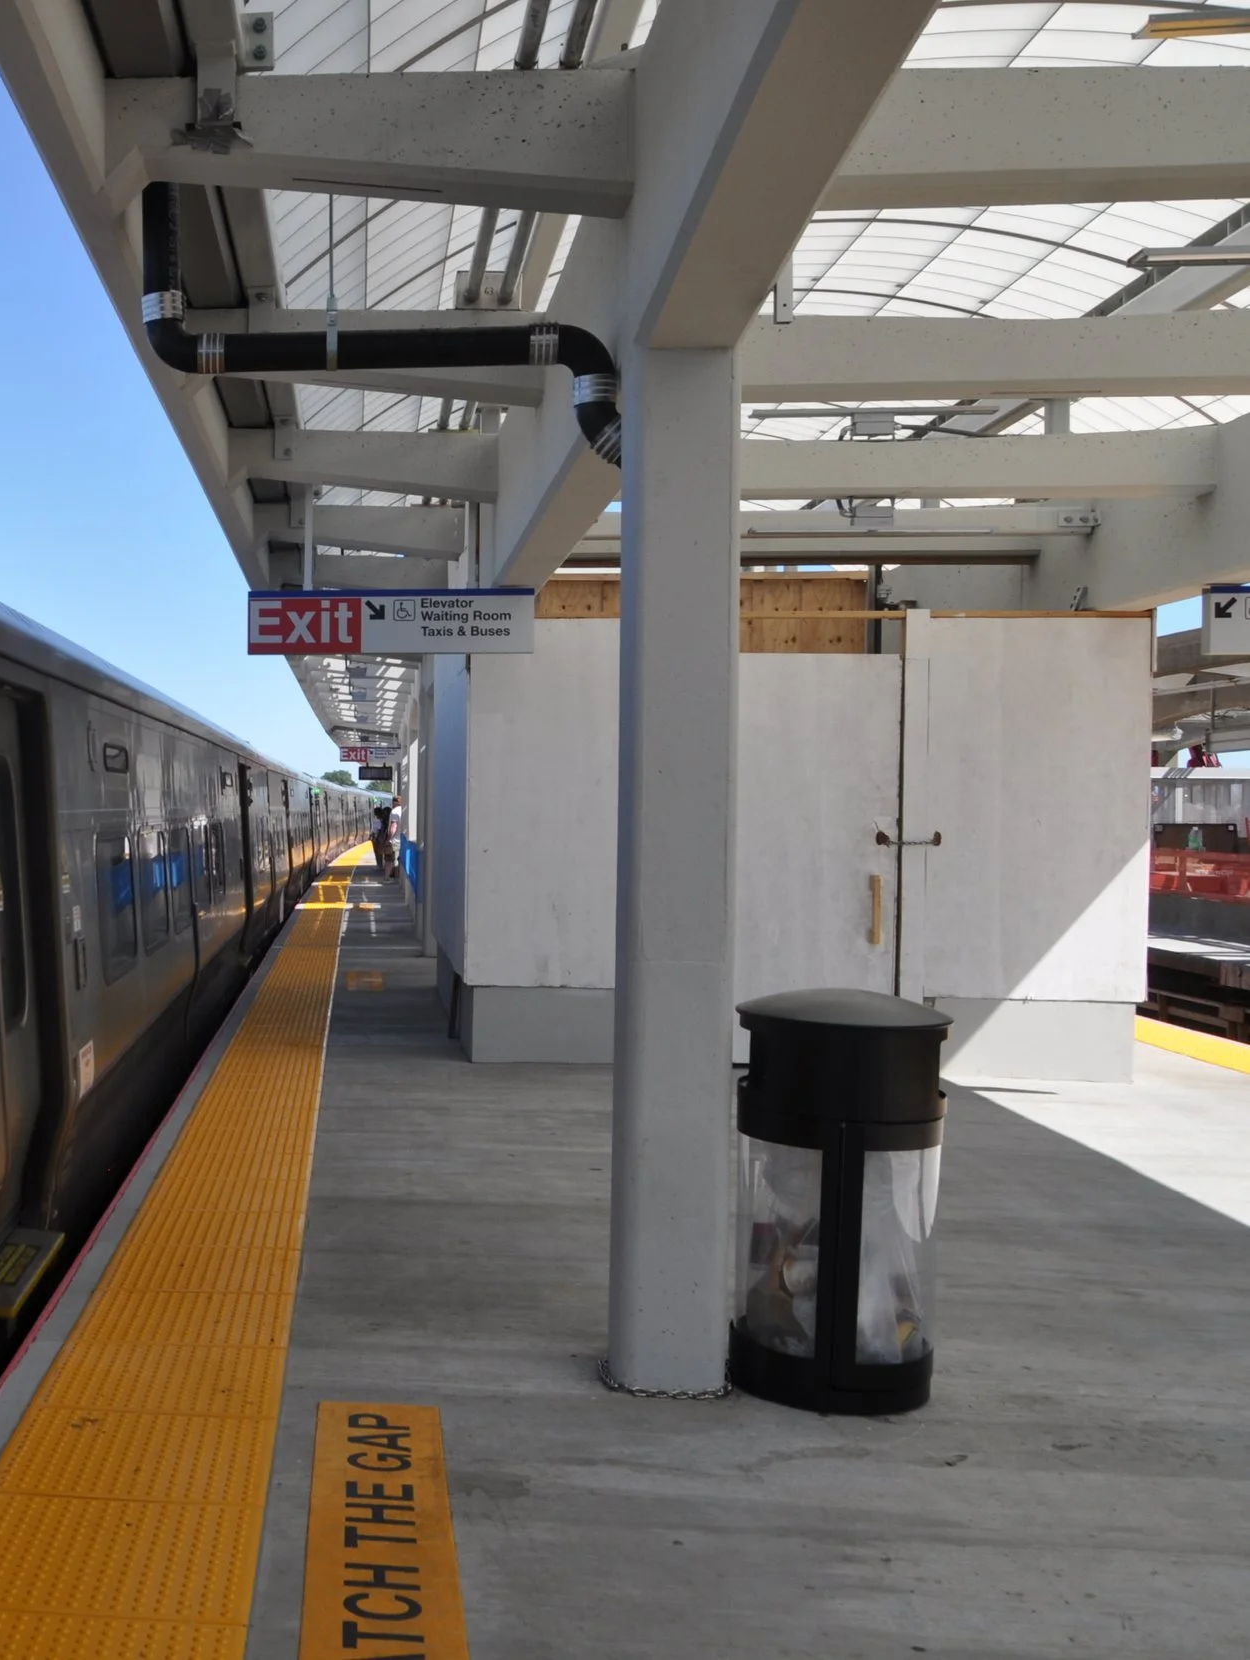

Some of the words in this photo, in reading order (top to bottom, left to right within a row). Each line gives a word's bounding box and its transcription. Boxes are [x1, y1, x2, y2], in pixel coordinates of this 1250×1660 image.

[420, 598, 474, 609] Elevator
[420, 611, 469, 623] Waiting
[473, 611, 512, 622] Room
[250, 600, 353, 644] Exit
[420, 626, 454, 637] Taxis
[456, 626, 466, 637] &
[470, 626, 511, 637] Buses
[341, 749, 366, 760] Exit
[347, 1412, 412, 1472] GAP
[344, 1481, 417, 1548] THE
[342, 1562, 426, 1660] TCH
